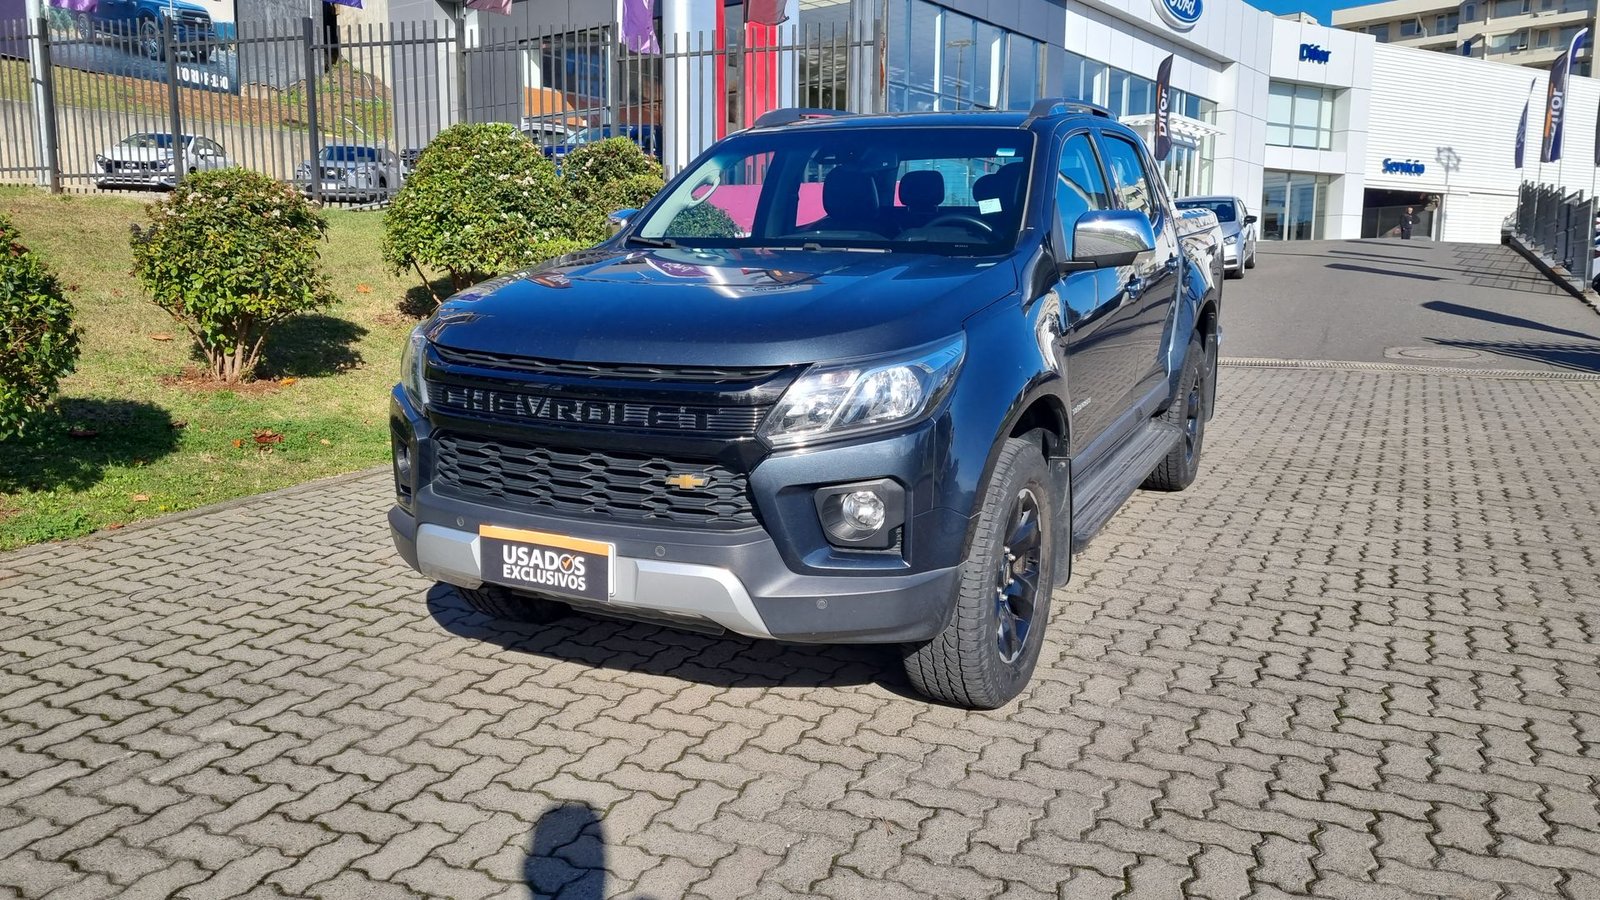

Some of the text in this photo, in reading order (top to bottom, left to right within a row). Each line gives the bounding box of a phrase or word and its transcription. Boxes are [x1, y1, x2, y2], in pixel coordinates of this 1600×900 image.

[1158, 88, 1168, 137] Difor
[1382, 158, 1425, 176] Servicio
[441, 385, 721, 430] CHEVROLET
[502, 544, 586, 576] USADOS
[502, 564, 586, 591] EXCLUSIVOS
